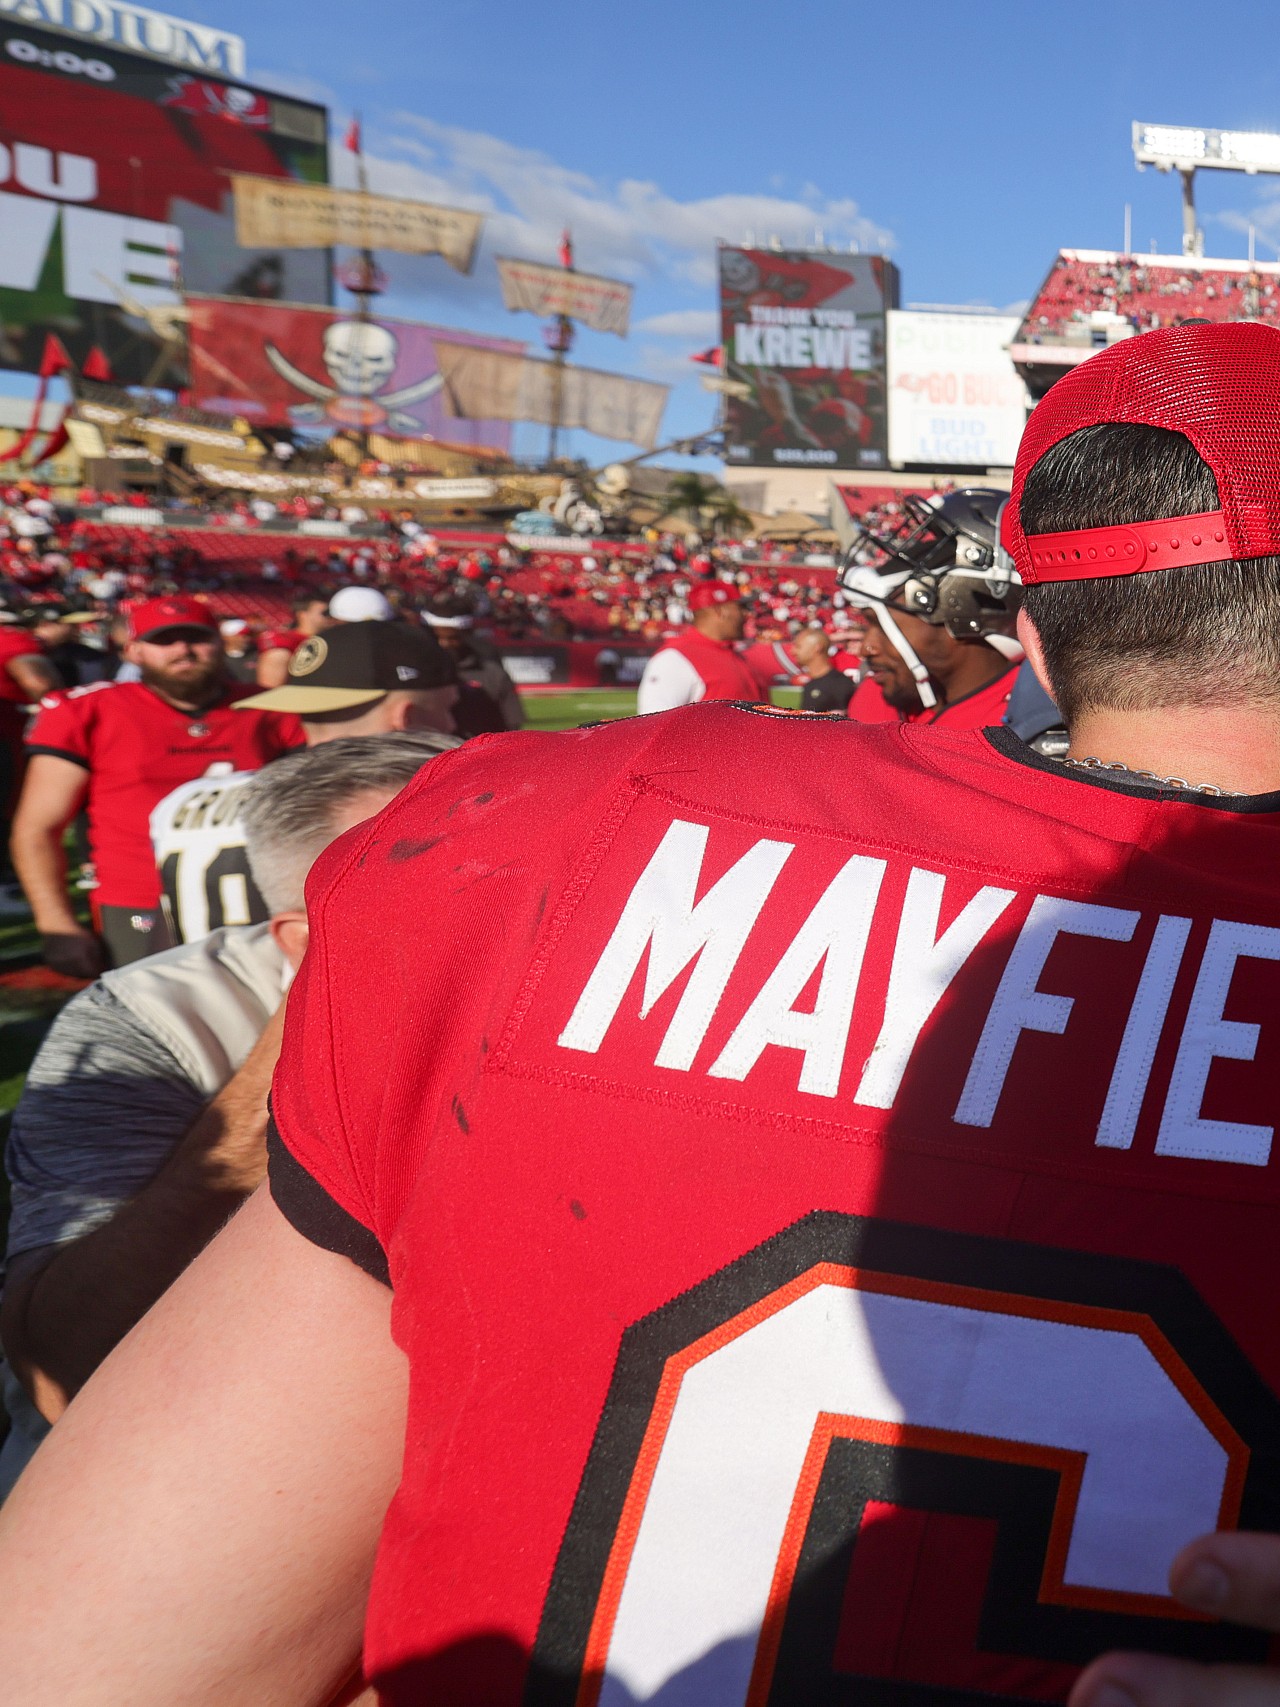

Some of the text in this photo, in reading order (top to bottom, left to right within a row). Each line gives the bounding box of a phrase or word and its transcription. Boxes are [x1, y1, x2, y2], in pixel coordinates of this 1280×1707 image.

[735, 324, 871, 369] KREWE
[930, 417, 986, 436] BUD
[919, 436, 995, 457] LIGHT
